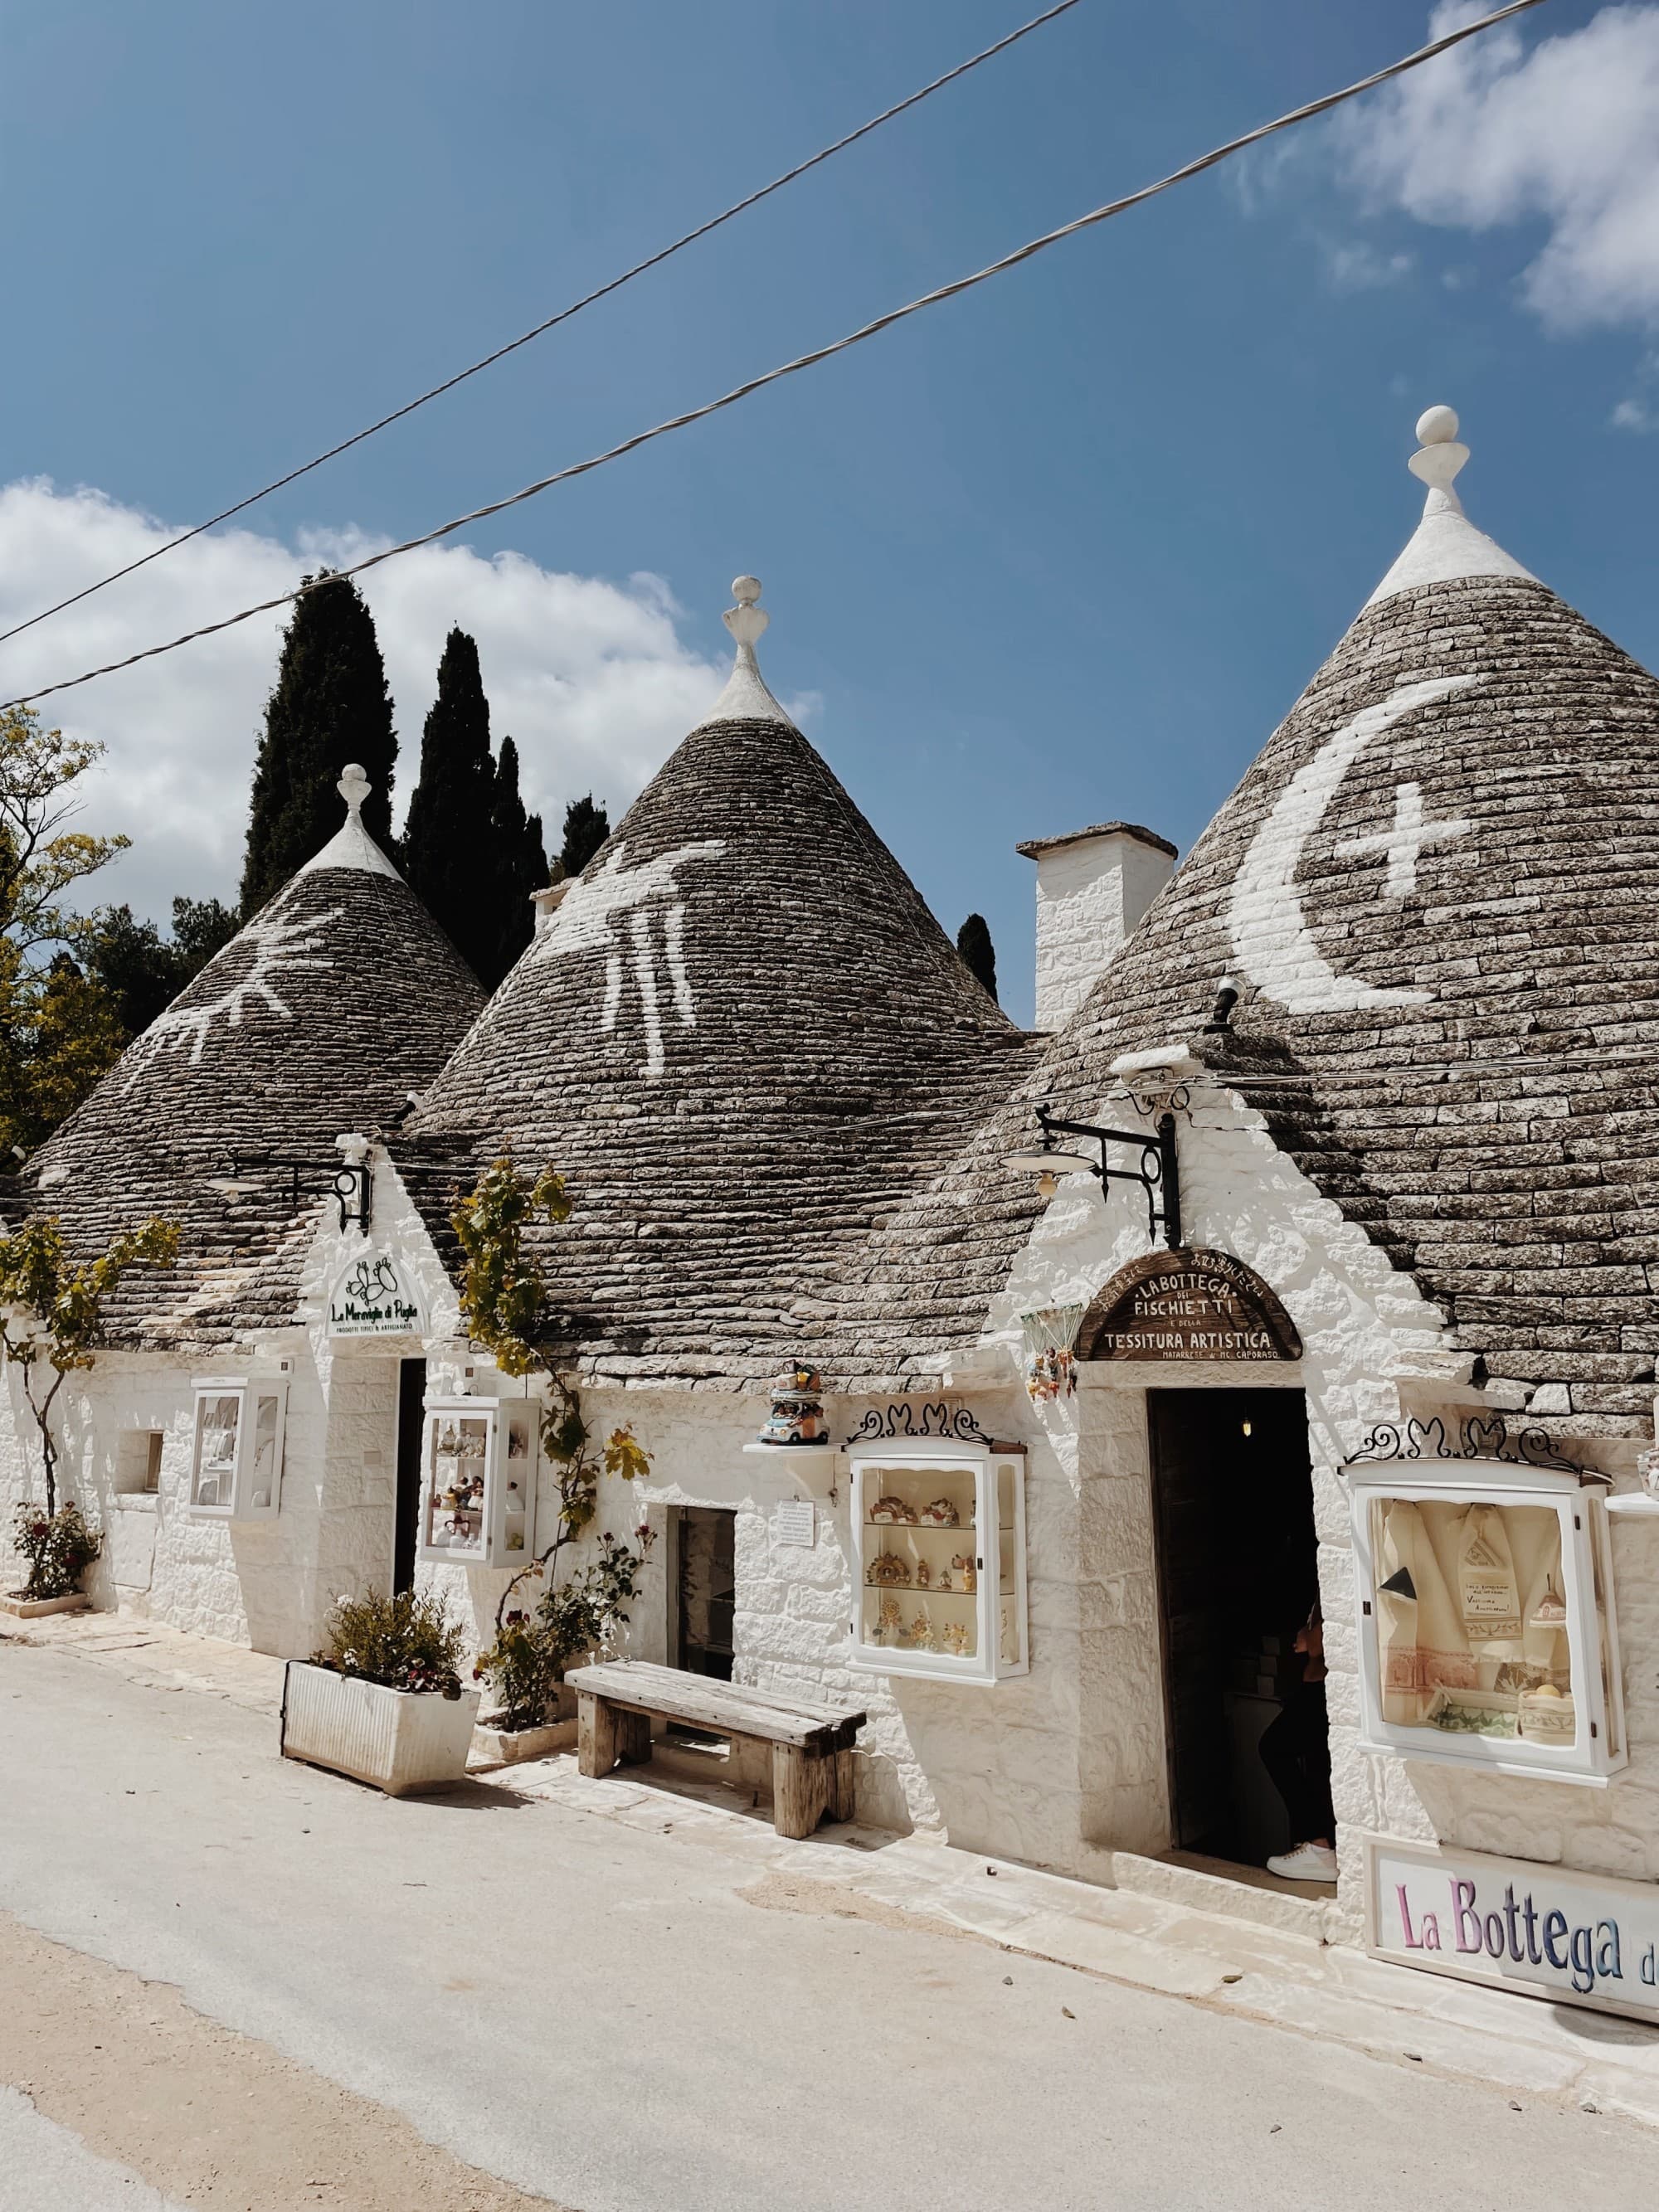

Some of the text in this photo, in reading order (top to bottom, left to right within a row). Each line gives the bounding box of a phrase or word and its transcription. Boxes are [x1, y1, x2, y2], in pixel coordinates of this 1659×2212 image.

[1177, 1291, 1189, 1300] DEI
[384, 1305, 392, 1319] di
[393, 1299, 418, 1322] Puglia
[1135, 1299, 1232, 1316] FISCHIETTI
[381, 1323, 413, 1331] ARTIGIANATO
[1104, 1332, 1271, 1349] TESSITURA ARTISTICA
[1162, 1351, 1203, 1359] MATARRESE
[1236, 1351, 1278, 1359] CAPORASO
[1395, 1879, 1659, 1994] La Bottega d
